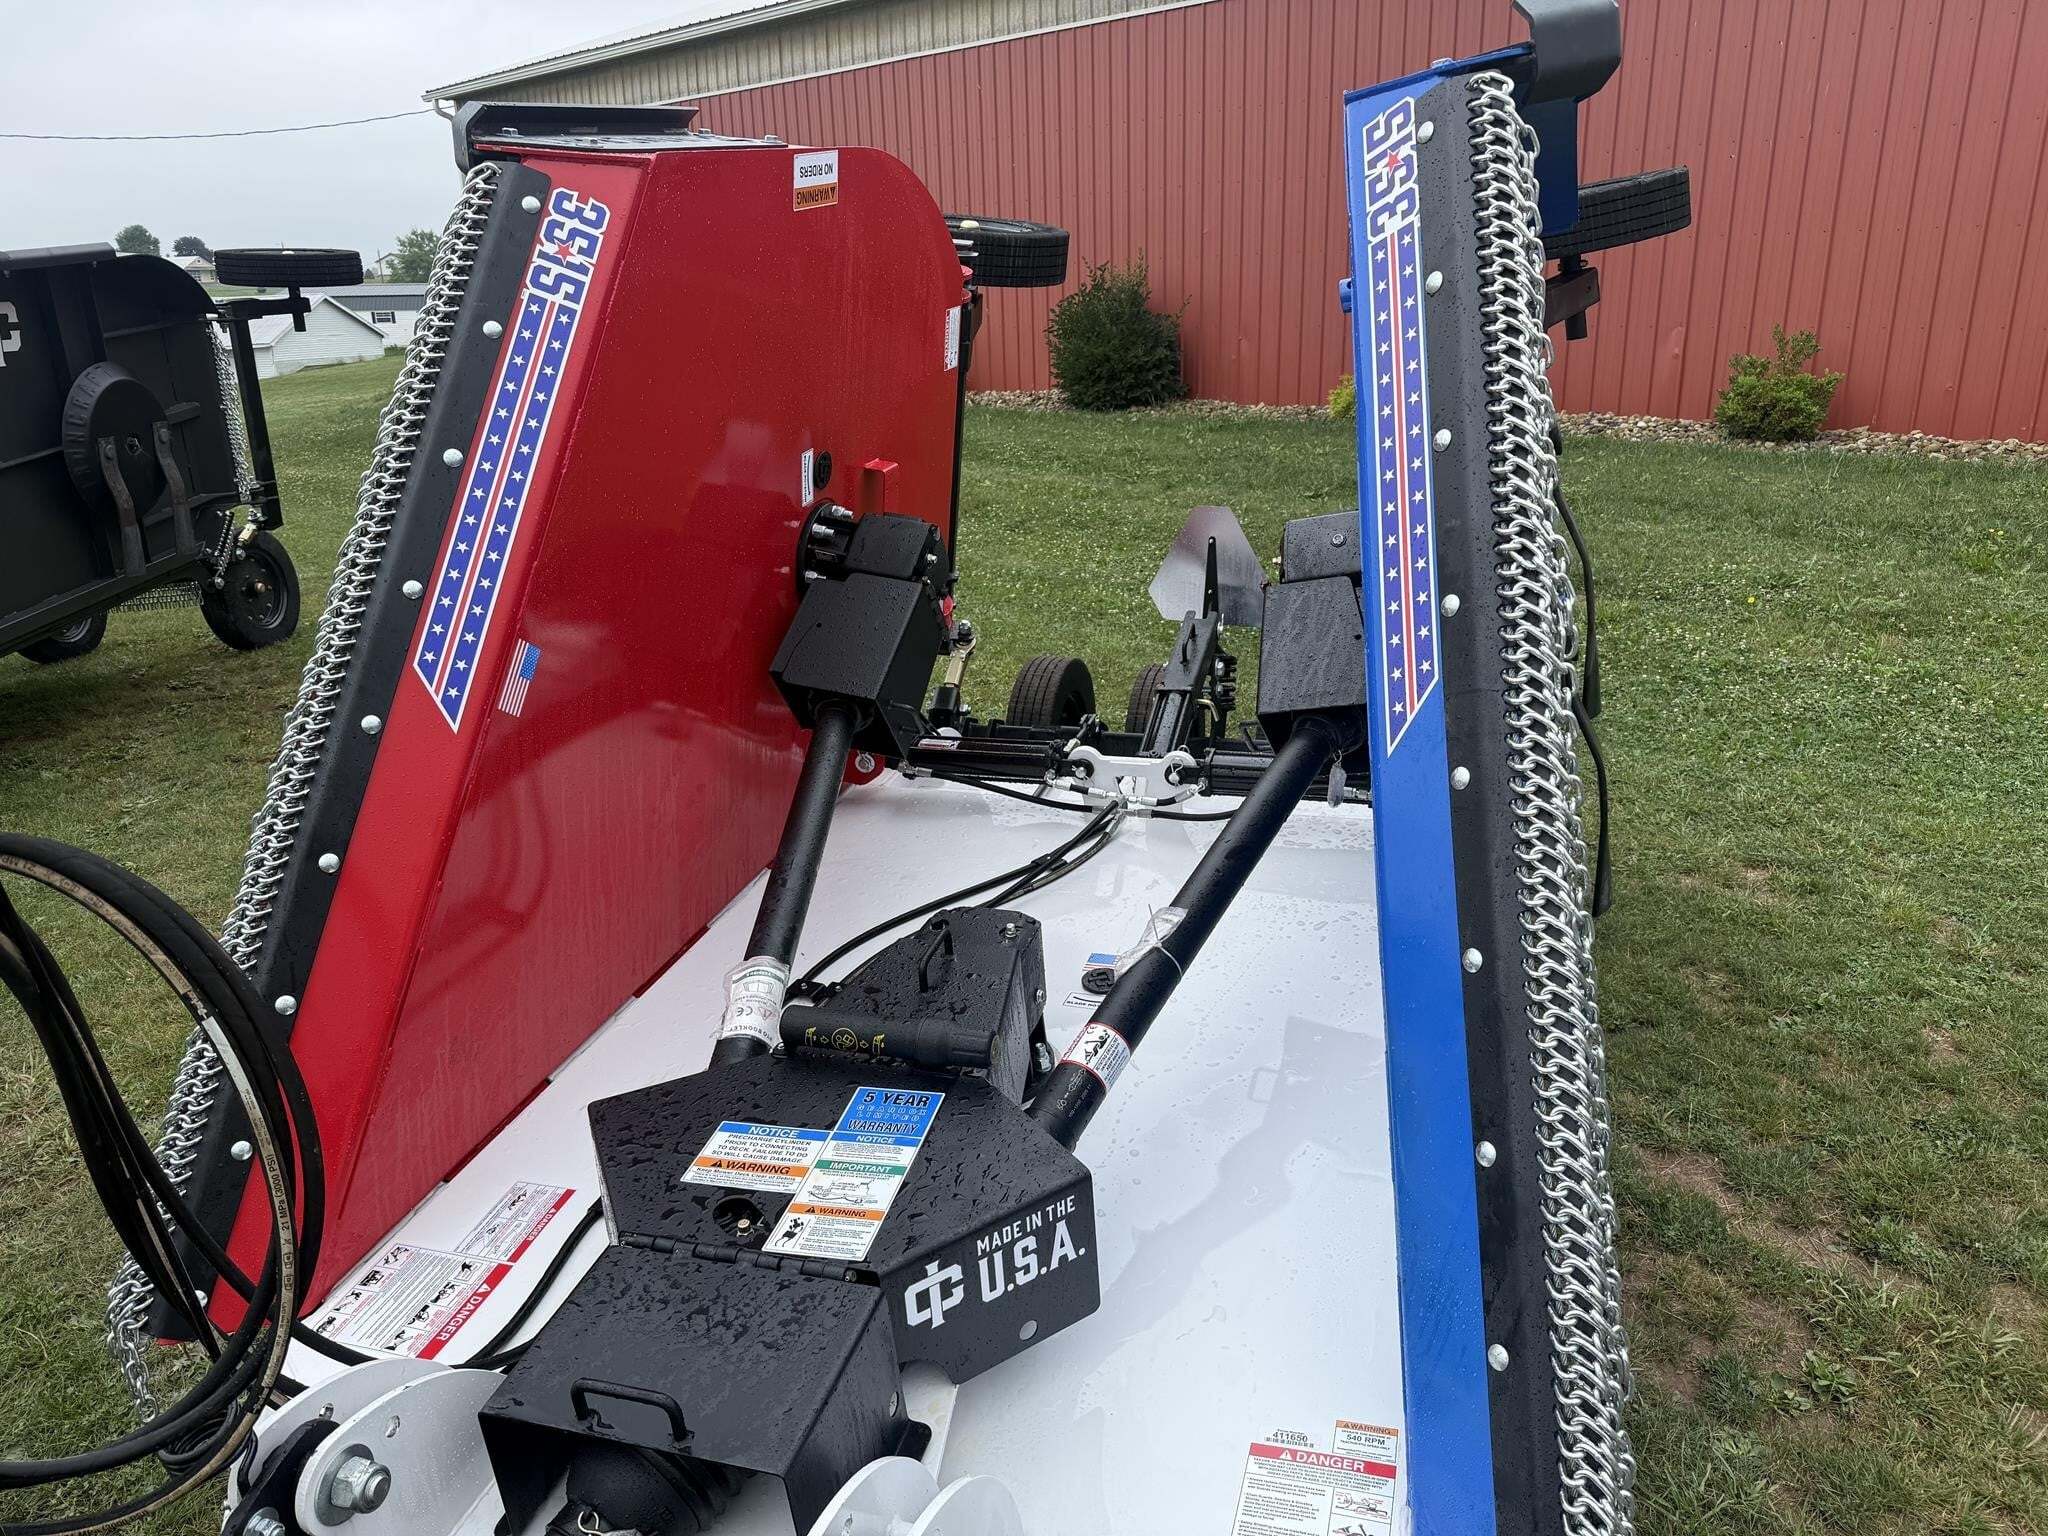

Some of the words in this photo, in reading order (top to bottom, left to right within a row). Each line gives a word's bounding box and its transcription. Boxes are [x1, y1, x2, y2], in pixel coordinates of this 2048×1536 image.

[800, 165, 823, 178] RIDERS
[824, 163, 834, 175] NO
[1364, 98, 1419, 239] 3515
[796, 188, 830, 205] WARNING
[528, 188, 608, 306] 3515
[863, 1090, 876, 1104] 5
[882, 1092, 930, 1107] YEAR
[748, 1126, 800, 1138] NOTICE
[848, 1119, 920, 1135] WARRANTY
[728, 1134, 774, 1143] PRECHARGE
[775, 1137, 812, 1146] CYLINDER
[856, 1135, 896, 1144] NOTICE
[760, 1143, 808, 1152] CONNECTING
[726, 1160, 791, 1175] WARNING
[830, 1162, 892, 1173] IMPORTANT
[272, 1174, 284, 1198] (3000
[278, 1200, 288, 1218] MPa
[818, 1207, 866, 1218] WARNING
[282, 1220, 290, 1231] 21
[976, 1221, 1022, 1256] MADE
[1026, 1211, 1042, 1233] IN
[1046, 1195, 1076, 1222] THE
[978, 1219, 1086, 1303] U.S.A.
[434, 1295, 485, 1343] DANGER
[1350, 1424, 1391, 1434] WARNING
[1272, 1432, 1308, 1442] 411650
[1364, 1436, 1386, 1446] RPM
[1296, 1450, 1365, 1472] DANGER
